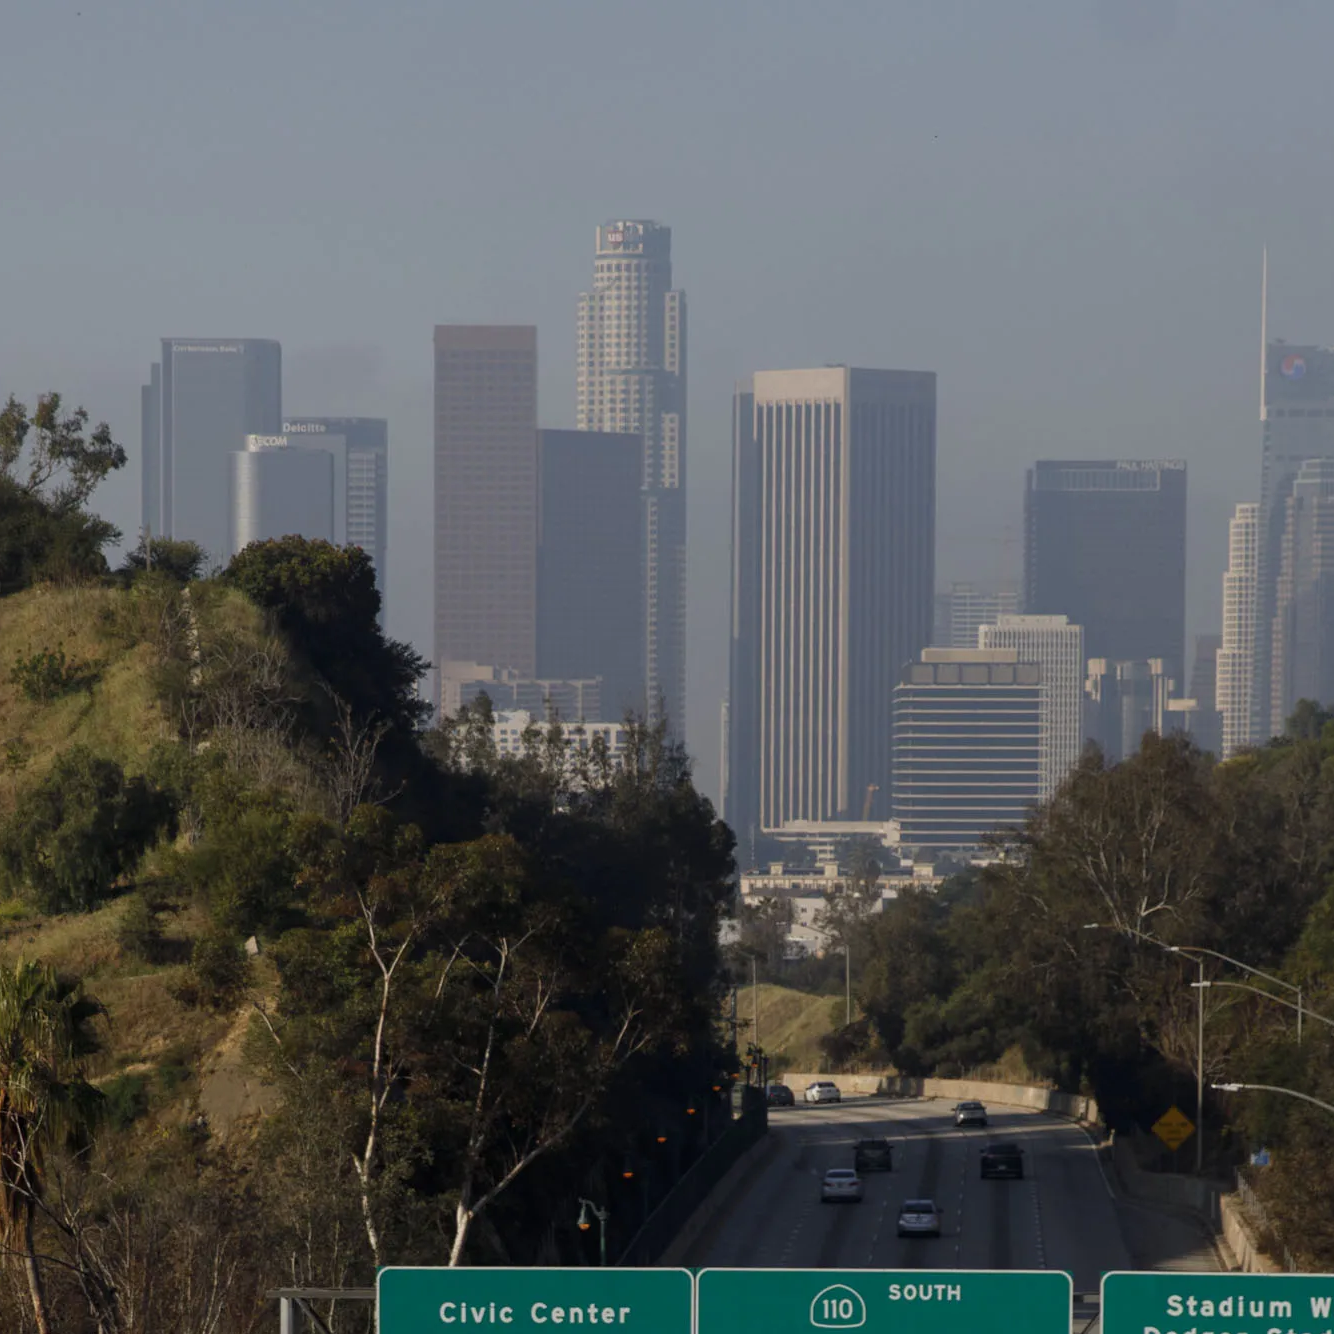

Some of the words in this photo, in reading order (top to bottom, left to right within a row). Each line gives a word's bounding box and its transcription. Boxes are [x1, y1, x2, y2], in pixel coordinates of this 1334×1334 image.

[888, 1284, 961, 1301] SOUTH
[439, 1302, 514, 1324] Civic
[530, 1302, 631, 1324] Center
[823, 1298, 854, 1320] 110
[1166, 1295, 1292, 1318] Stadium
